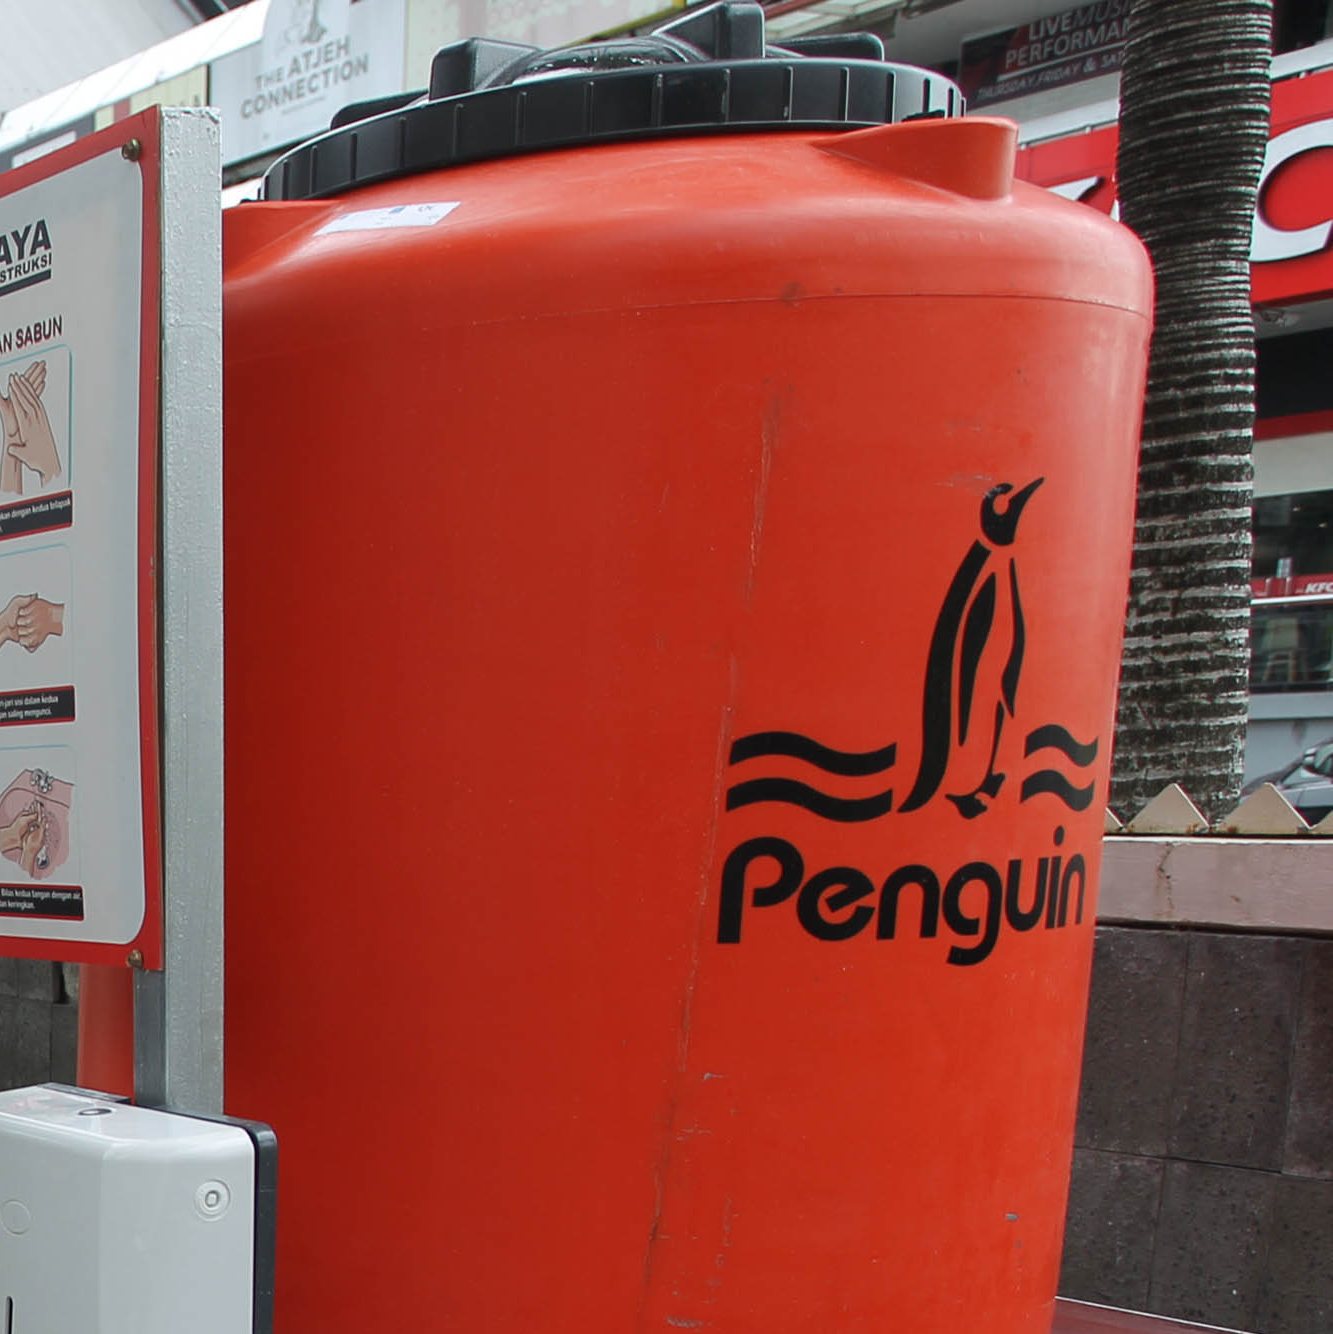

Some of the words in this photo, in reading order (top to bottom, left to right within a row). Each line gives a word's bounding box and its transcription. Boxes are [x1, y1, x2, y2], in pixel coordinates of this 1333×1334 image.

[255, 69, 283, 90] THE
[287, 36, 351, 77] ATJEH
[1004, 18, 1130, 71] PERFORMAN
[1101, 51, 1125, 68] SAT
[240, 53, 370, 119] CONNECTION
[15, 315, 63, 348] SABUN
[716, 825, 1084, 967] Penguin
